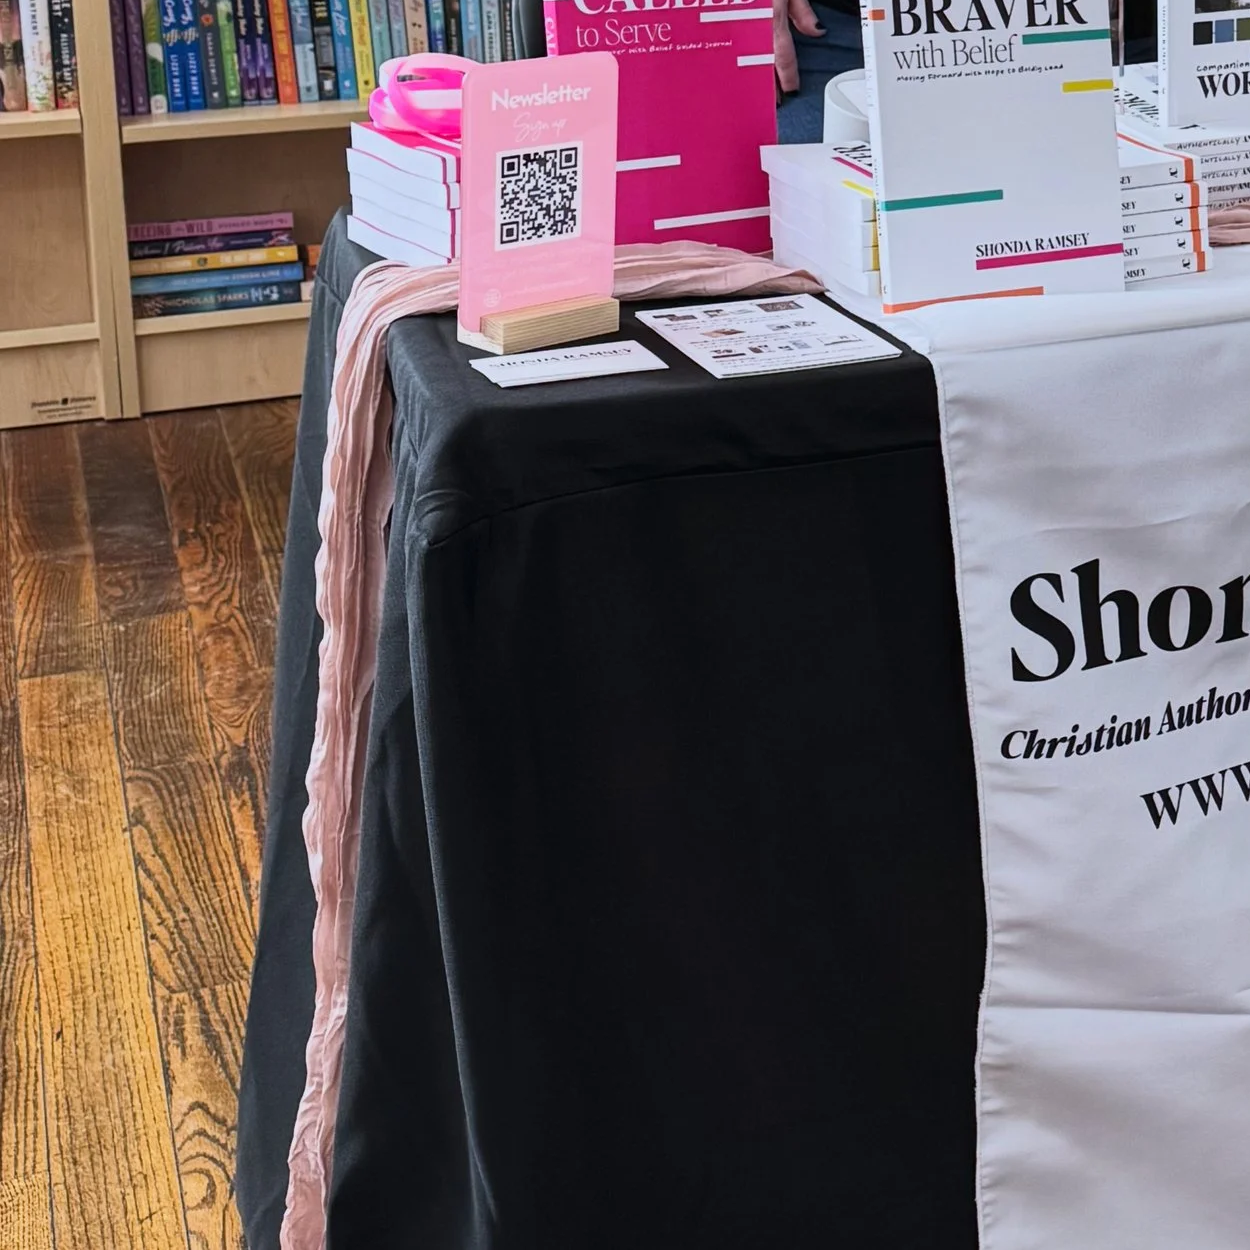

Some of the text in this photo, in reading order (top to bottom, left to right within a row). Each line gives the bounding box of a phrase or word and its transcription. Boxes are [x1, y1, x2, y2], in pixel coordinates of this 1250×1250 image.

[576, 18, 672, 48] to Serve
[676, 42, 702, 52] Guided
[705, 39, 732, 49] Journal
[893, 33, 1018, 70] with Belief
[896, 73, 926, 83] Moving
[928, 70, 963, 81] Forward
[964, 69, 983, 77] with
[1196, 60, 1250, 73] companion
[490, 81, 592, 112] Newsletter
[975, 231, 1090, 259] SHONDA RAMSEY
[1000, 713, 1152, 760] Christian
